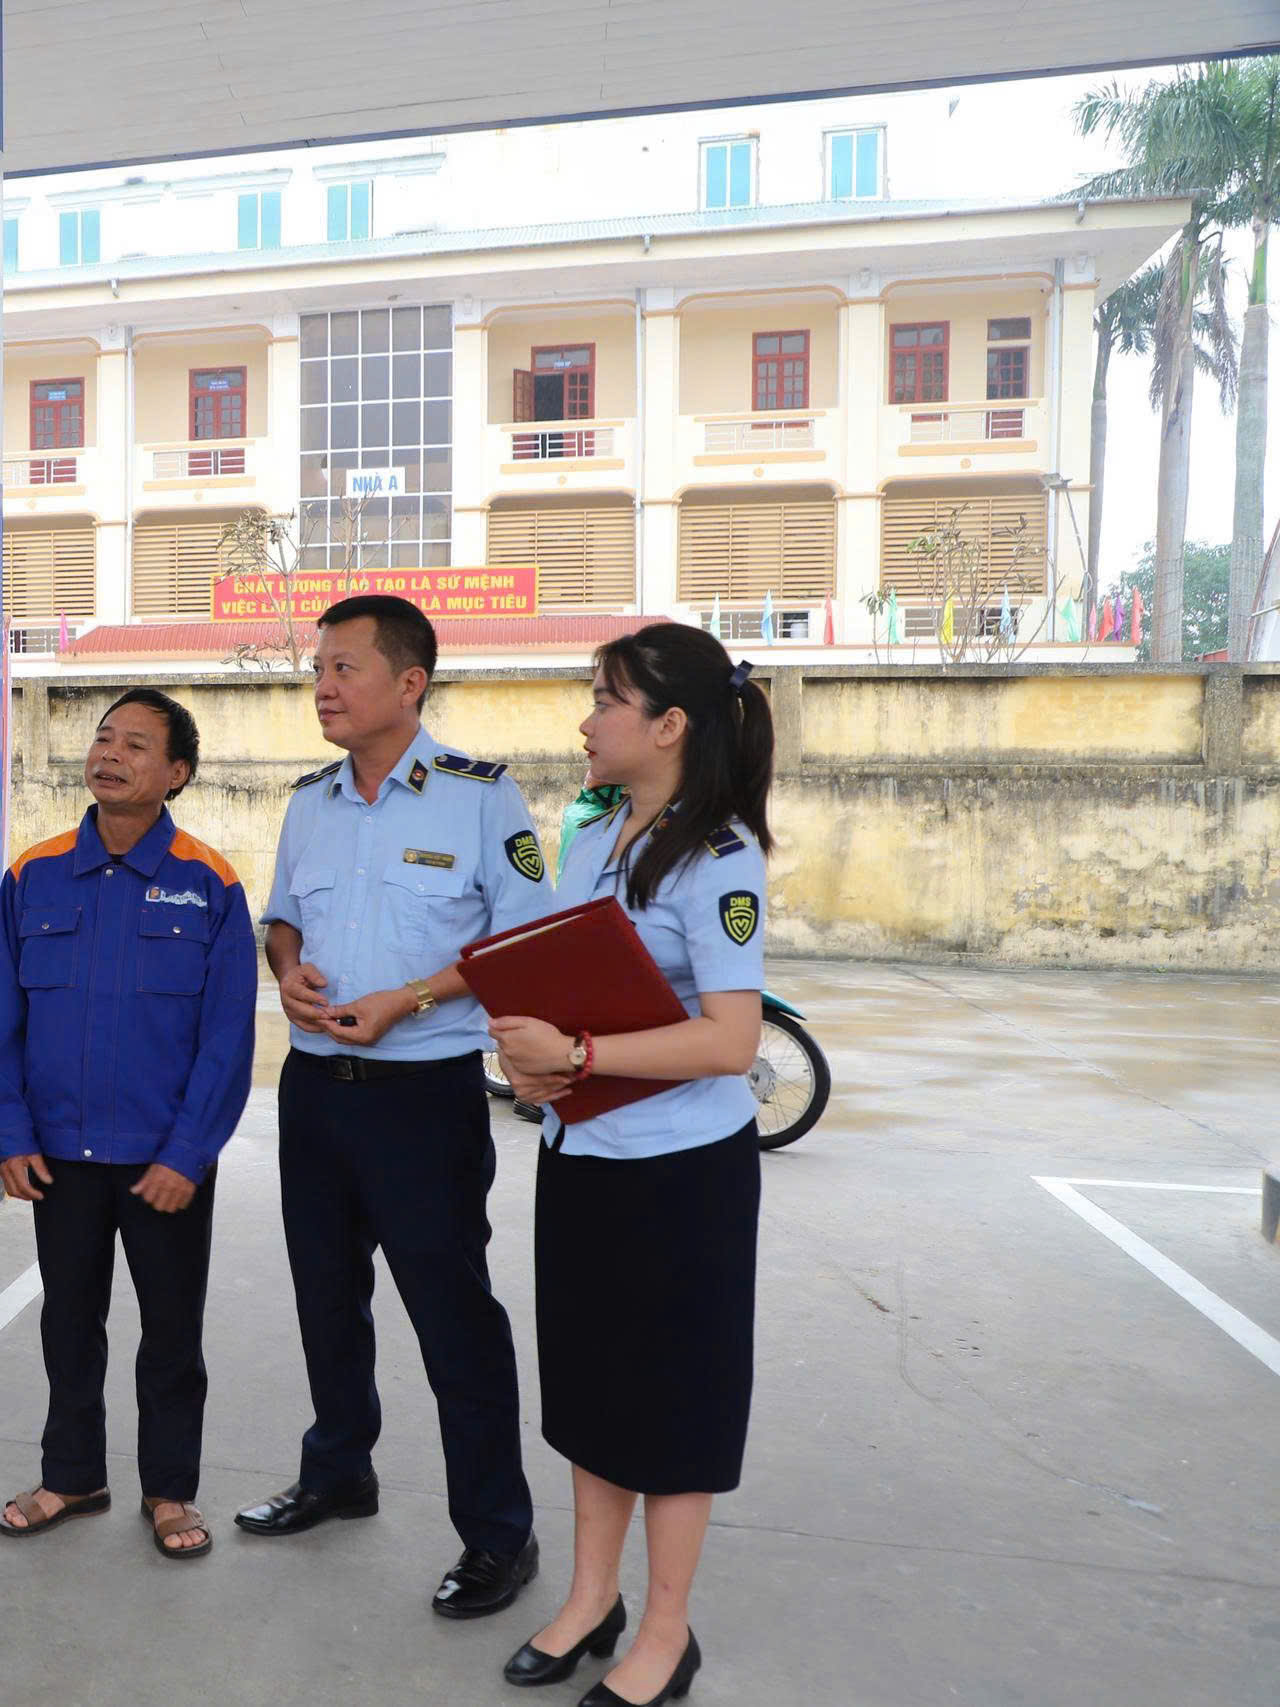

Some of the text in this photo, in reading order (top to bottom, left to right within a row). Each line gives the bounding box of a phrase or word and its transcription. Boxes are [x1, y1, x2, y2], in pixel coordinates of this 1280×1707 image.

[352, 472, 398, 492] NHÀ A
[375, 577, 406, 593] TẠO
[410, 575, 432, 591] LÀ
[436, 574, 462, 590] SỨ
[464, 572, 515, 592] MỆNH
[222, 598, 257, 616] VIỆC
[421, 594, 441, 610] LÀ
[446, 596, 485, 612] MỤC
[490, 594, 527, 609] TIÊU
[730, 896, 752, 907] DMS
